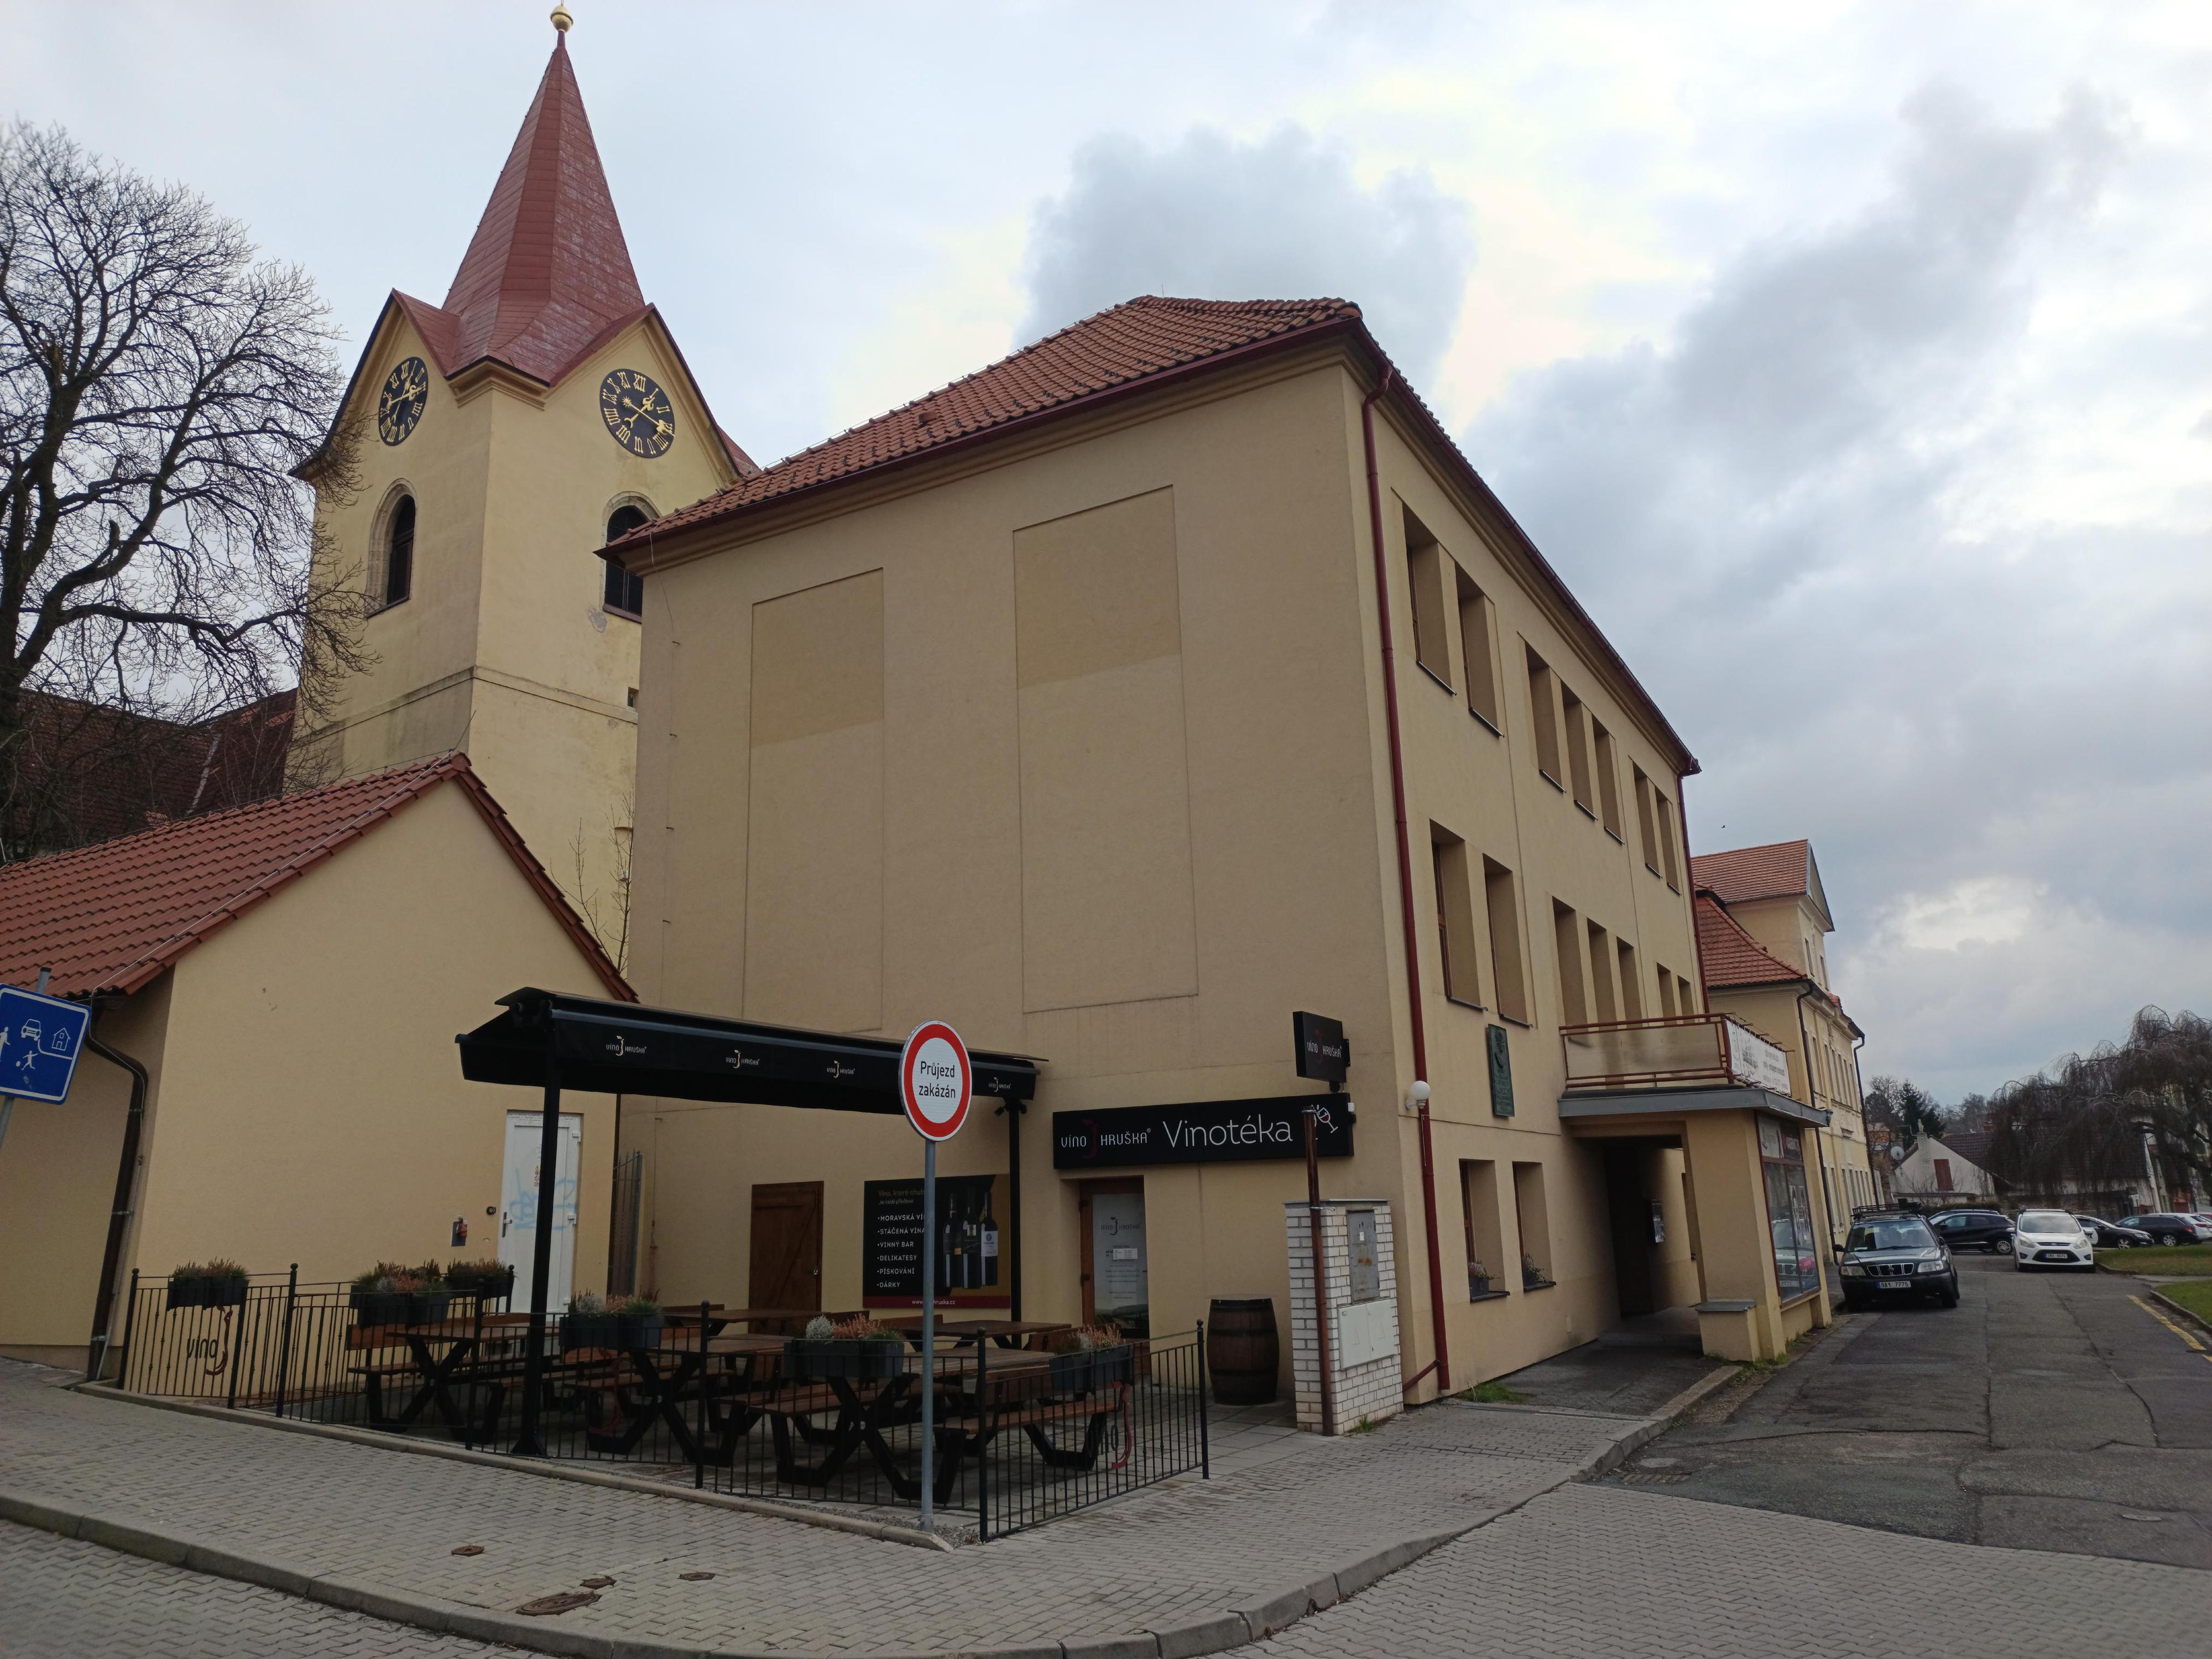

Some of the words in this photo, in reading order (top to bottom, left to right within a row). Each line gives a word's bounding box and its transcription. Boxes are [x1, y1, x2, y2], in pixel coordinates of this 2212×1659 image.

[1307, 1040, 1318, 1053] víno
[921, 1061, 954, 1079] Průjezd
[919, 1083, 955, 1098] zakázán
[1162, 1114, 1293, 1147] Vinotéka
[1061, 1135, 1087, 1147] víno
